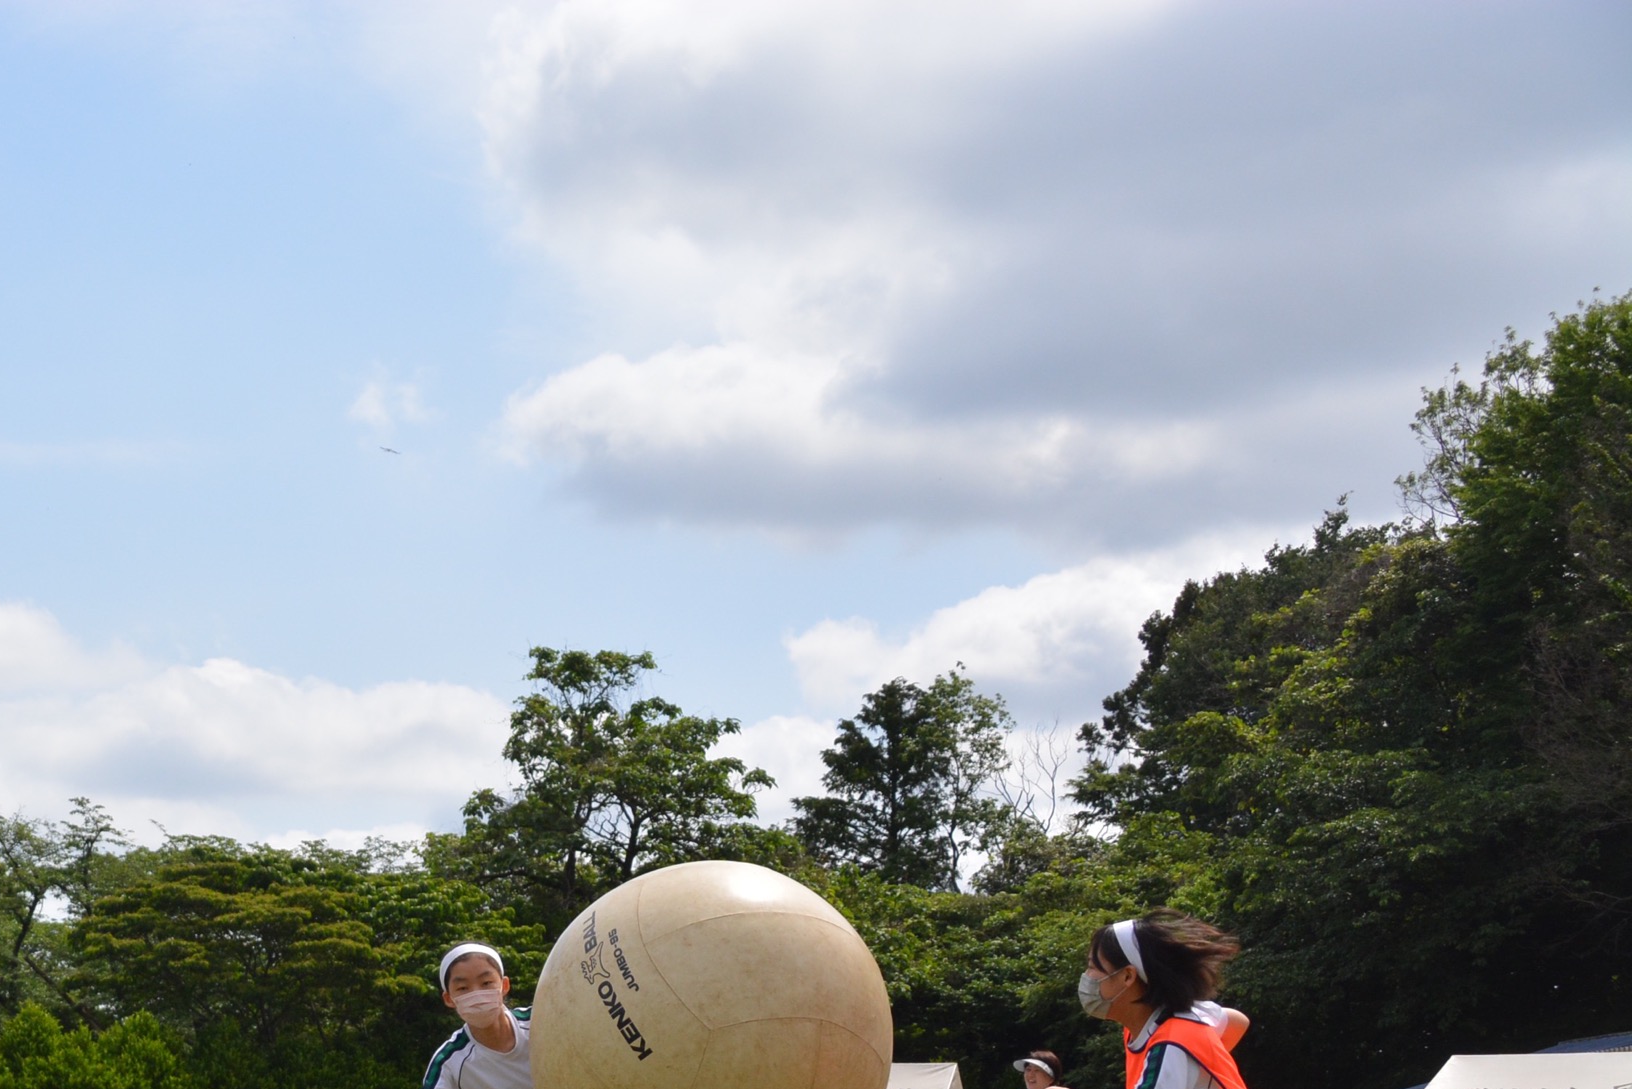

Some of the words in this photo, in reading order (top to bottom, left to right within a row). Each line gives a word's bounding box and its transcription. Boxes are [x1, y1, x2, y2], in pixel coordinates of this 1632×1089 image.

[583, 911, 597, 954] BALL
[608, 928, 640, 992] JUMBO-95
[598, 980, 653, 1061] KENKO
